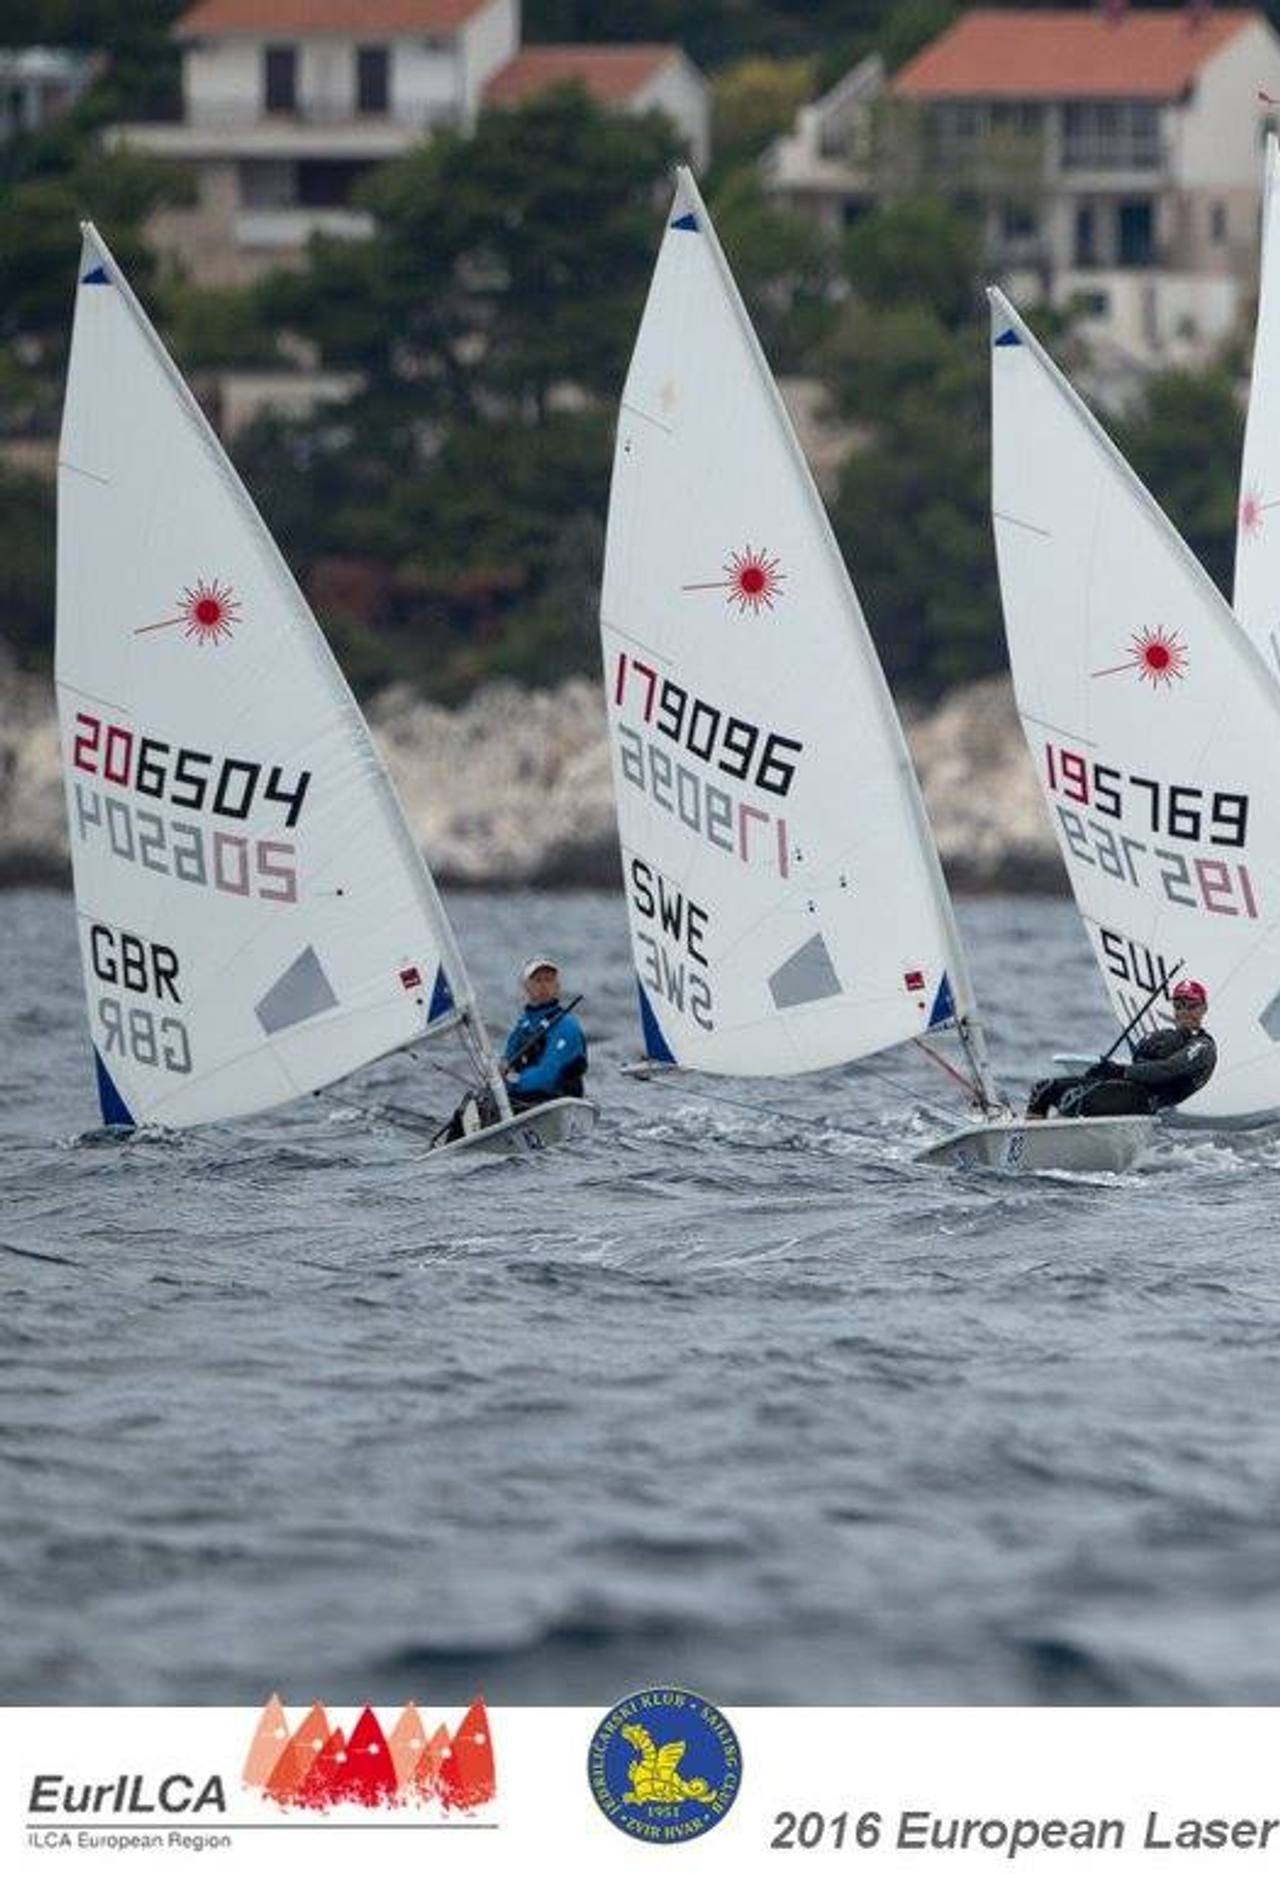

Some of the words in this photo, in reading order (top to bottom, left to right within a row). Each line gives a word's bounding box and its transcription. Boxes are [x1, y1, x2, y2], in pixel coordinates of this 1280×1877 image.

[73, 712, 311, 828] 206504
[616, 653, 802, 797] 179096
[1046, 743, 1249, 848] 195769
[91, 924, 182, 1004] GBR
[631, 857, 709, 968] SWE
